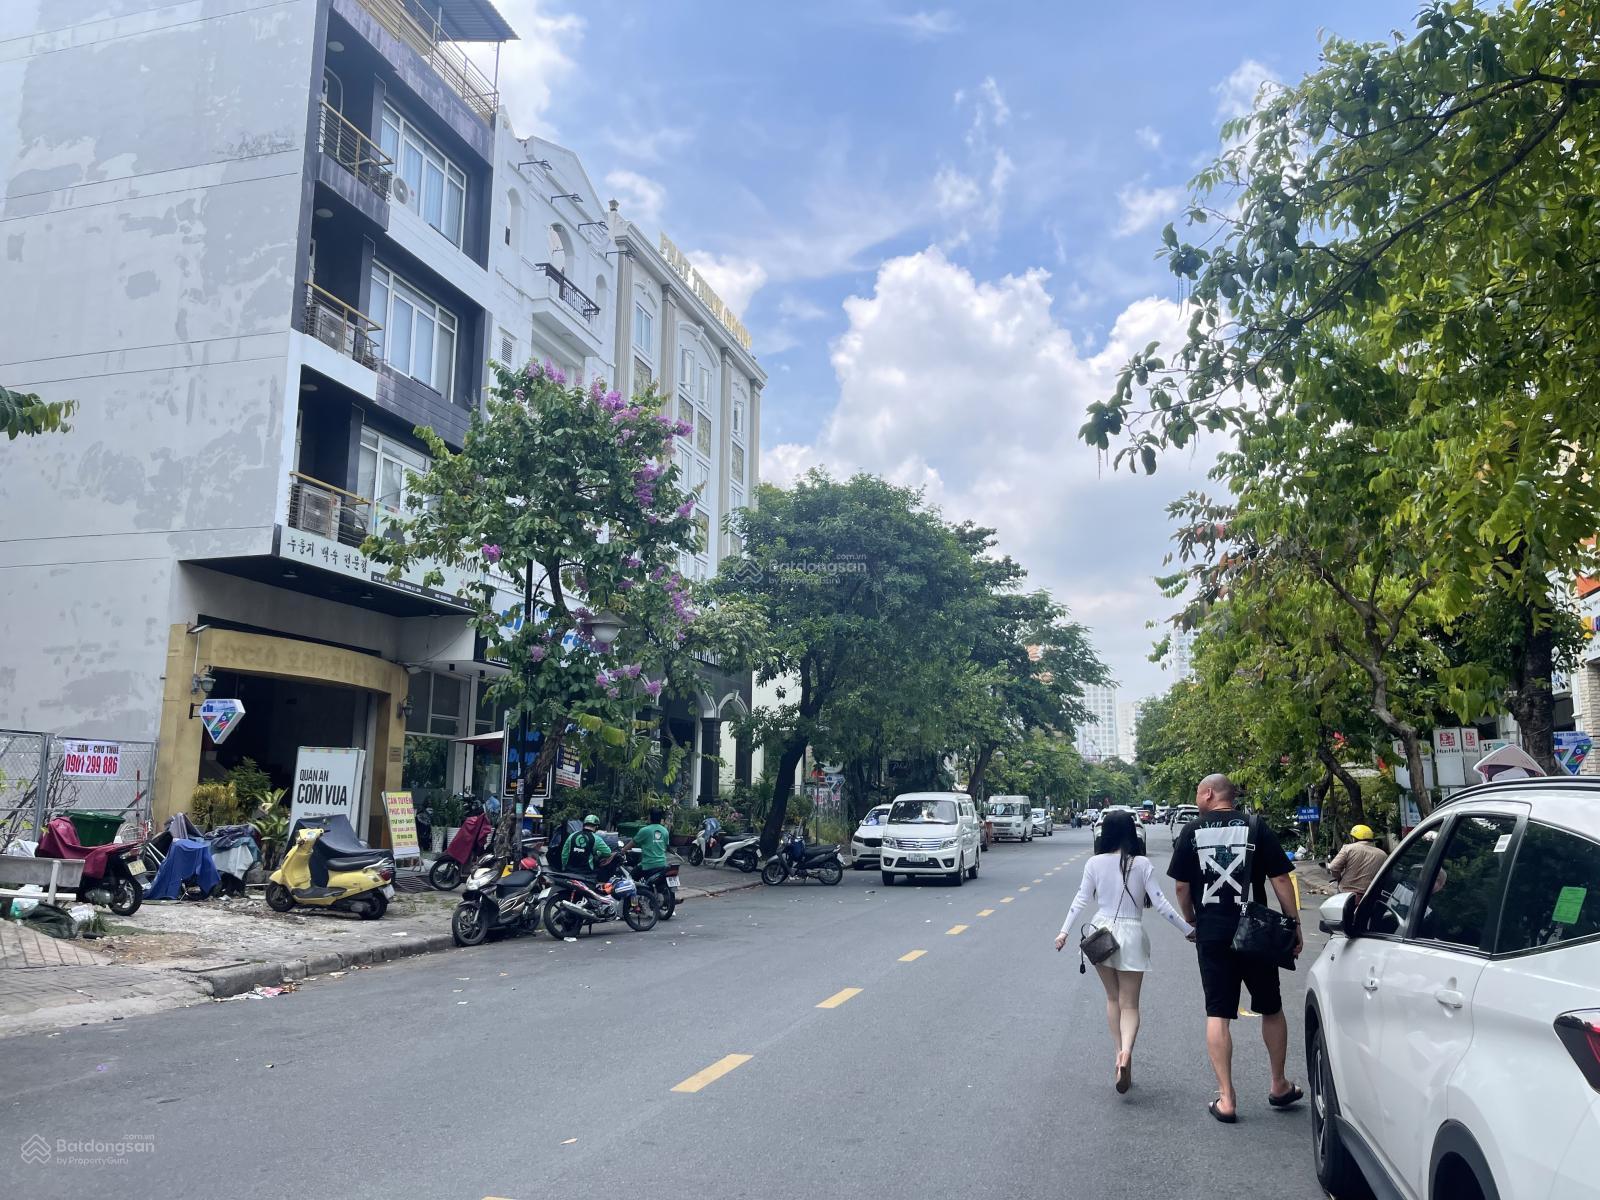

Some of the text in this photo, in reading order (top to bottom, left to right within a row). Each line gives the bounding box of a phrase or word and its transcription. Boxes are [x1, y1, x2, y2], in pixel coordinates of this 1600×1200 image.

[287, 536, 314, 557] 누룽지
[321, 546, 338, 565] 백숙
[65, 754, 118, 774] 0901 299 886
[325, 785, 347, 806] VUA
